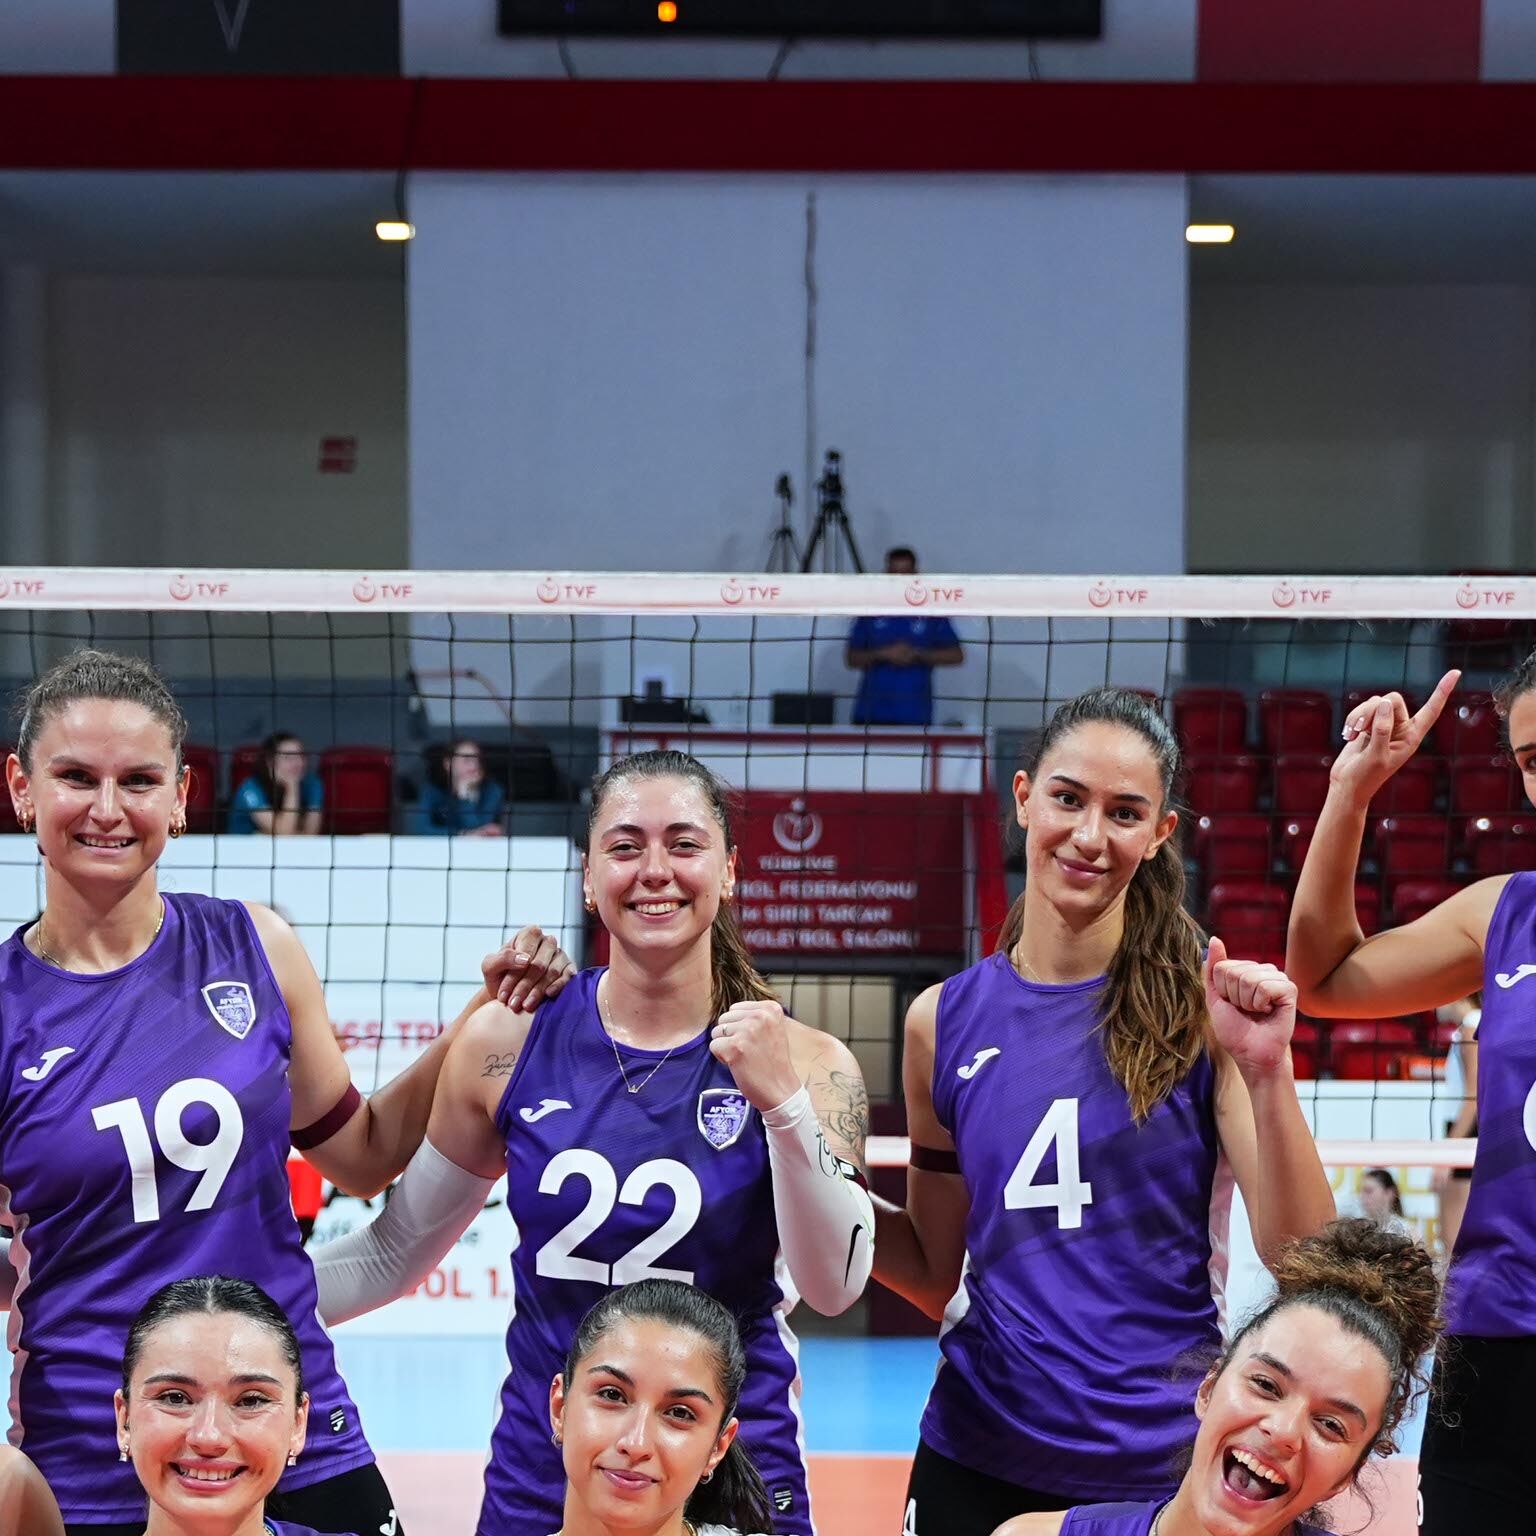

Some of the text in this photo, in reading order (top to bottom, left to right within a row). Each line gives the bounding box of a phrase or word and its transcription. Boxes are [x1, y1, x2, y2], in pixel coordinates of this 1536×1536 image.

[13, 581, 45, 595] TVF
[196, 583, 229, 597] TVF
[380, 585, 413, 599] TVF
[564, 585, 597, 599] TVF
[748, 586, 781, 600] TVF
[931, 589, 965, 603] TVF
[1116, 590, 1149, 604] TVF
[1299, 590, 1333, 604] TVF
[1482, 592, 1516, 606] TVF
[91, 1077, 245, 1223] 19
[1004, 1097, 1093, 1230] 4
[535, 1148, 703, 1286] 22
[409, 1268, 472, 1299] OL
